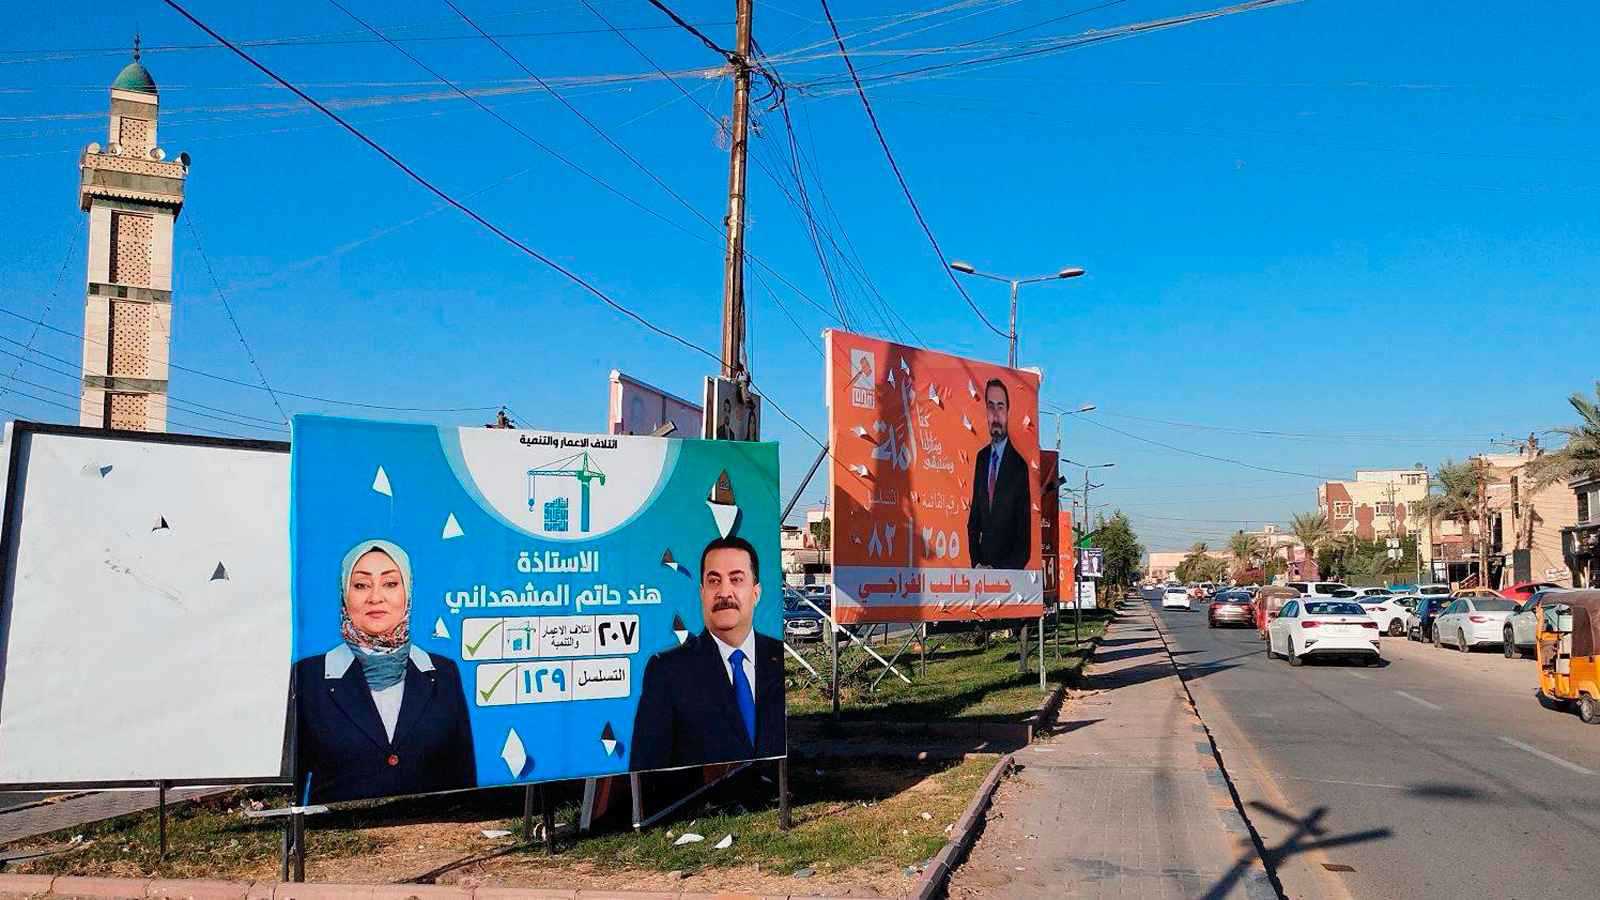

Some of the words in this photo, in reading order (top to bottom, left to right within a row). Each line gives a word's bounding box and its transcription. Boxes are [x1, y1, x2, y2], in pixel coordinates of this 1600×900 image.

[520, 434, 559, 449] والتنمية
[560, 437, 589, 449] الاعمار
[591, 439, 618, 449] ائتلاف
[516, 550, 599, 574] الاستاذة
[626, 583, 662, 605] هند
[858, 573, 925, 603] الفراجي
[929, 572, 970, 598] طالب
[974, 574, 1012, 598] حسام
[445, 582, 570, 614] المشهداني
[576, 583, 621, 613] حاتم
[598, 620, 637, 647] ٢٠٧
[522, 667, 567, 695] ١٢٩
[577, 668, 626, 687] التسلسل
